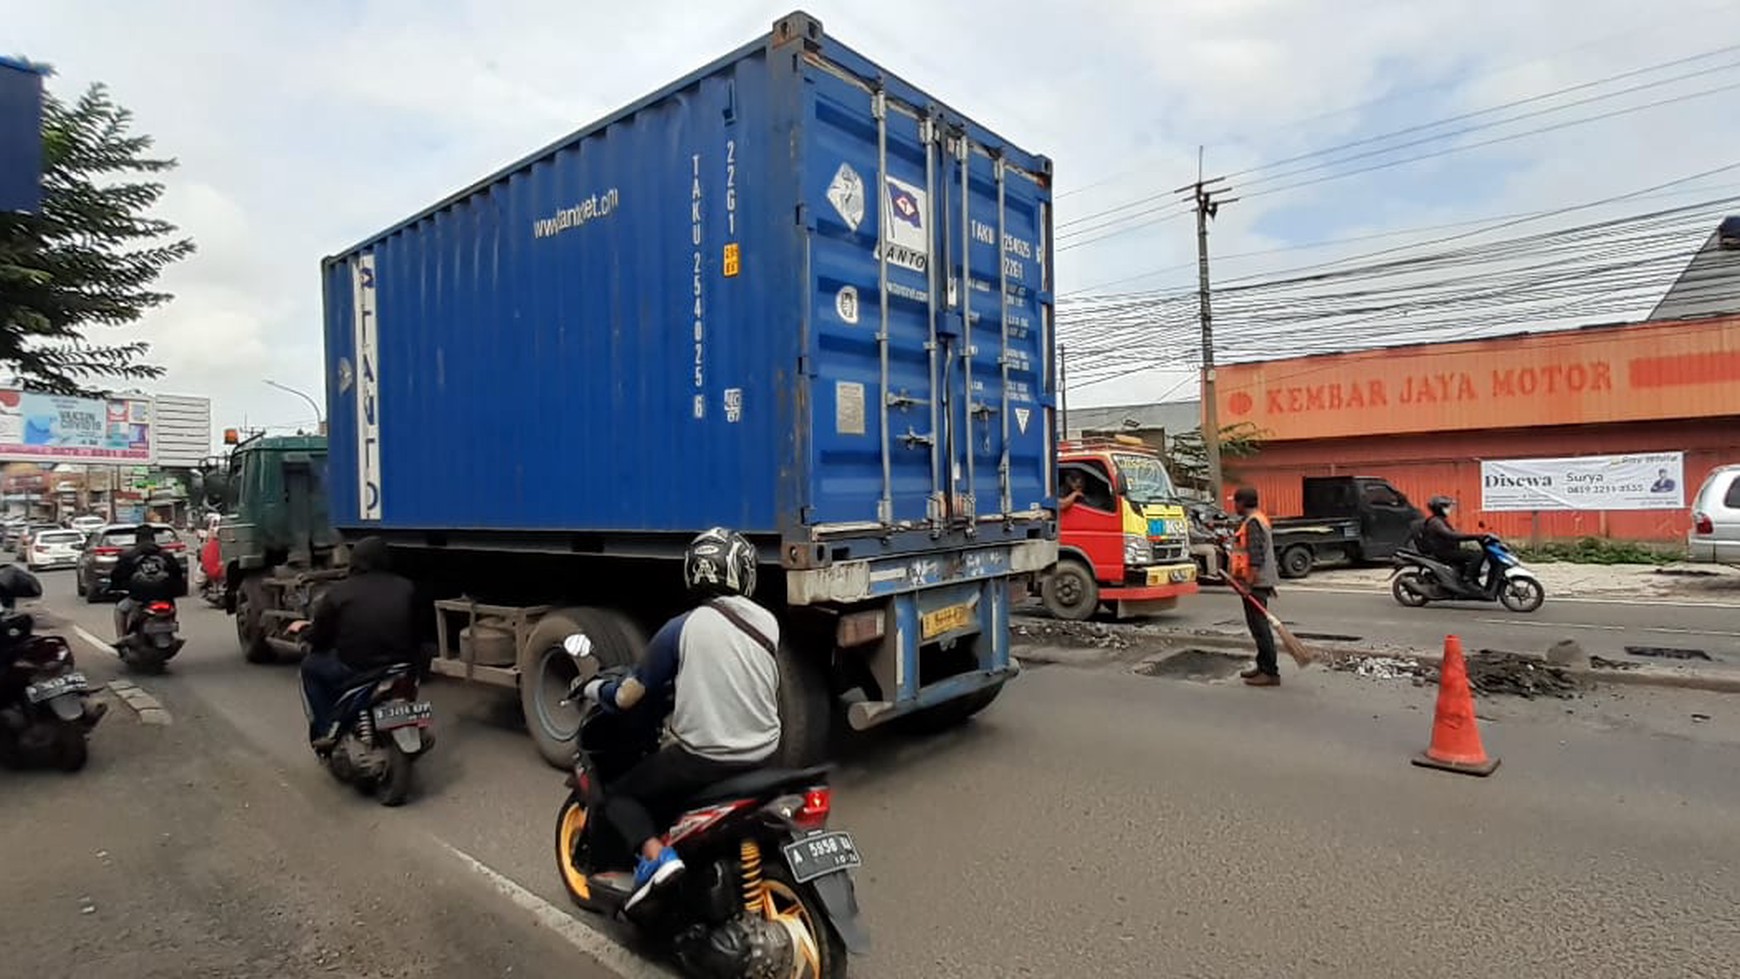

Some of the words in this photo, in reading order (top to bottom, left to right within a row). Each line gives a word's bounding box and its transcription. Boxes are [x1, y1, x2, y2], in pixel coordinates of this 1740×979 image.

[691, 154, 702, 245] TAKU
[877, 244, 927, 270] ANTO
[1266, 379, 1388, 415] KEMBAR
[1400, 371, 1477, 405] JAYA
[1491, 361, 1613, 398] MOTOR
[1484, 473, 1553, 488] Disewa
[1566, 472, 1604, 484] Surya
[793, 848, 804, 864] A
